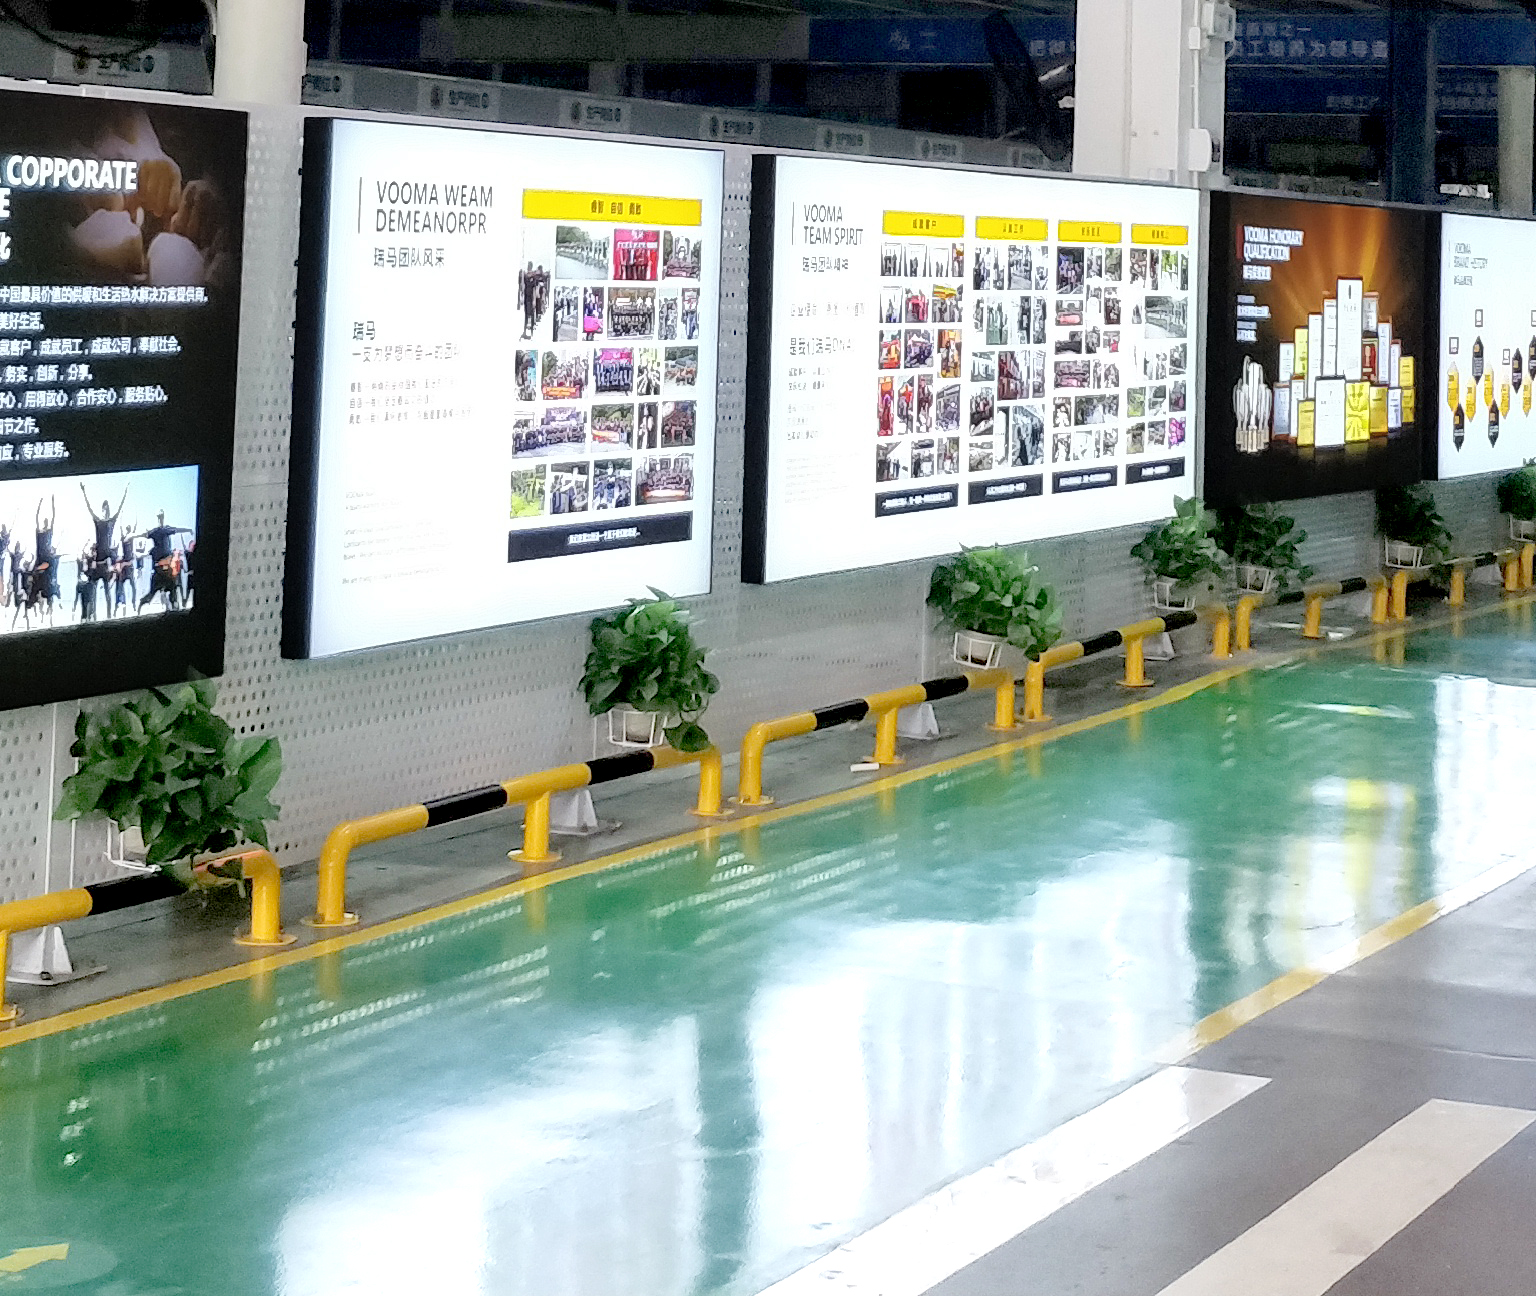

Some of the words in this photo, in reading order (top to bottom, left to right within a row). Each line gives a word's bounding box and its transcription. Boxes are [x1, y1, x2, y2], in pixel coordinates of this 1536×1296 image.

[7, 155, 139, 190] COPPORATE
[376, 181, 439, 206] VOOMA
[445, 184, 493, 208] WEAM
[376, 208, 487, 234] DEMEANORPR
[804, 204, 843, 222] VOOMA
[804, 226, 832, 245] TEAM
[835, 228, 863, 245] SPIRIT
[374, 247, 444, 268] 瑞马团队风采
